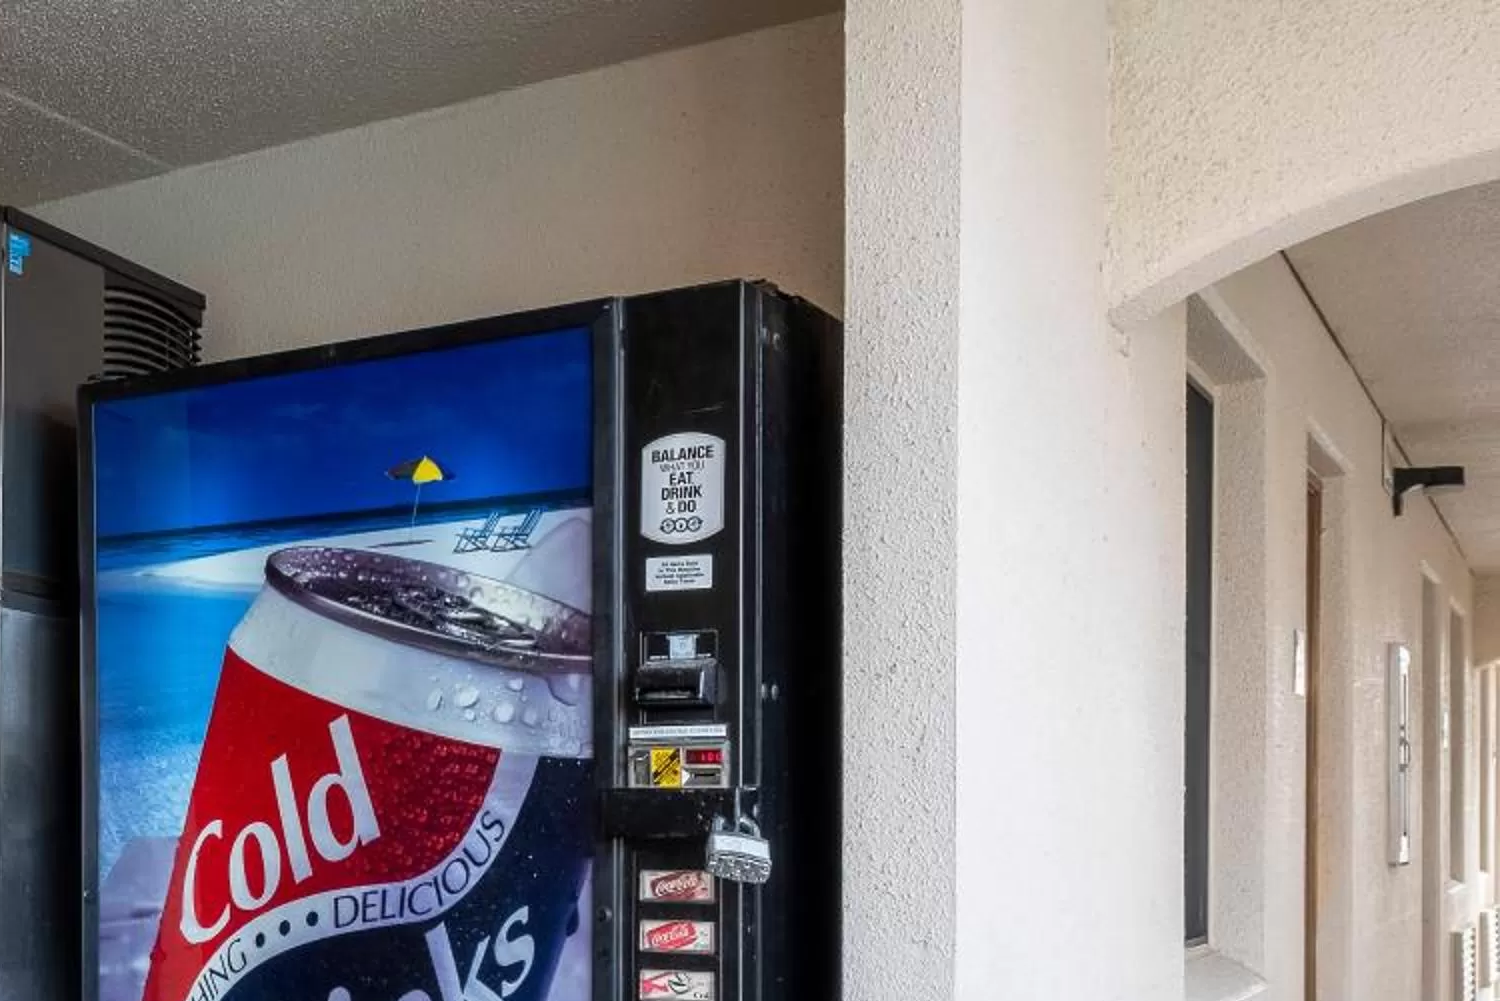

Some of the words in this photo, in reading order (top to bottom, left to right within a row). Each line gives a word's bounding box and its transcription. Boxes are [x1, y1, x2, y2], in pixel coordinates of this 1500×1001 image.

[652, 445, 715, 464] BALANCE
[661, 485, 703, 500] DRINK
[666, 502, 676, 514] &
[678, 500, 697, 513] DO
[179, 714, 381, 944] Cold
[332, 810, 506, 929] DELICIOUS
